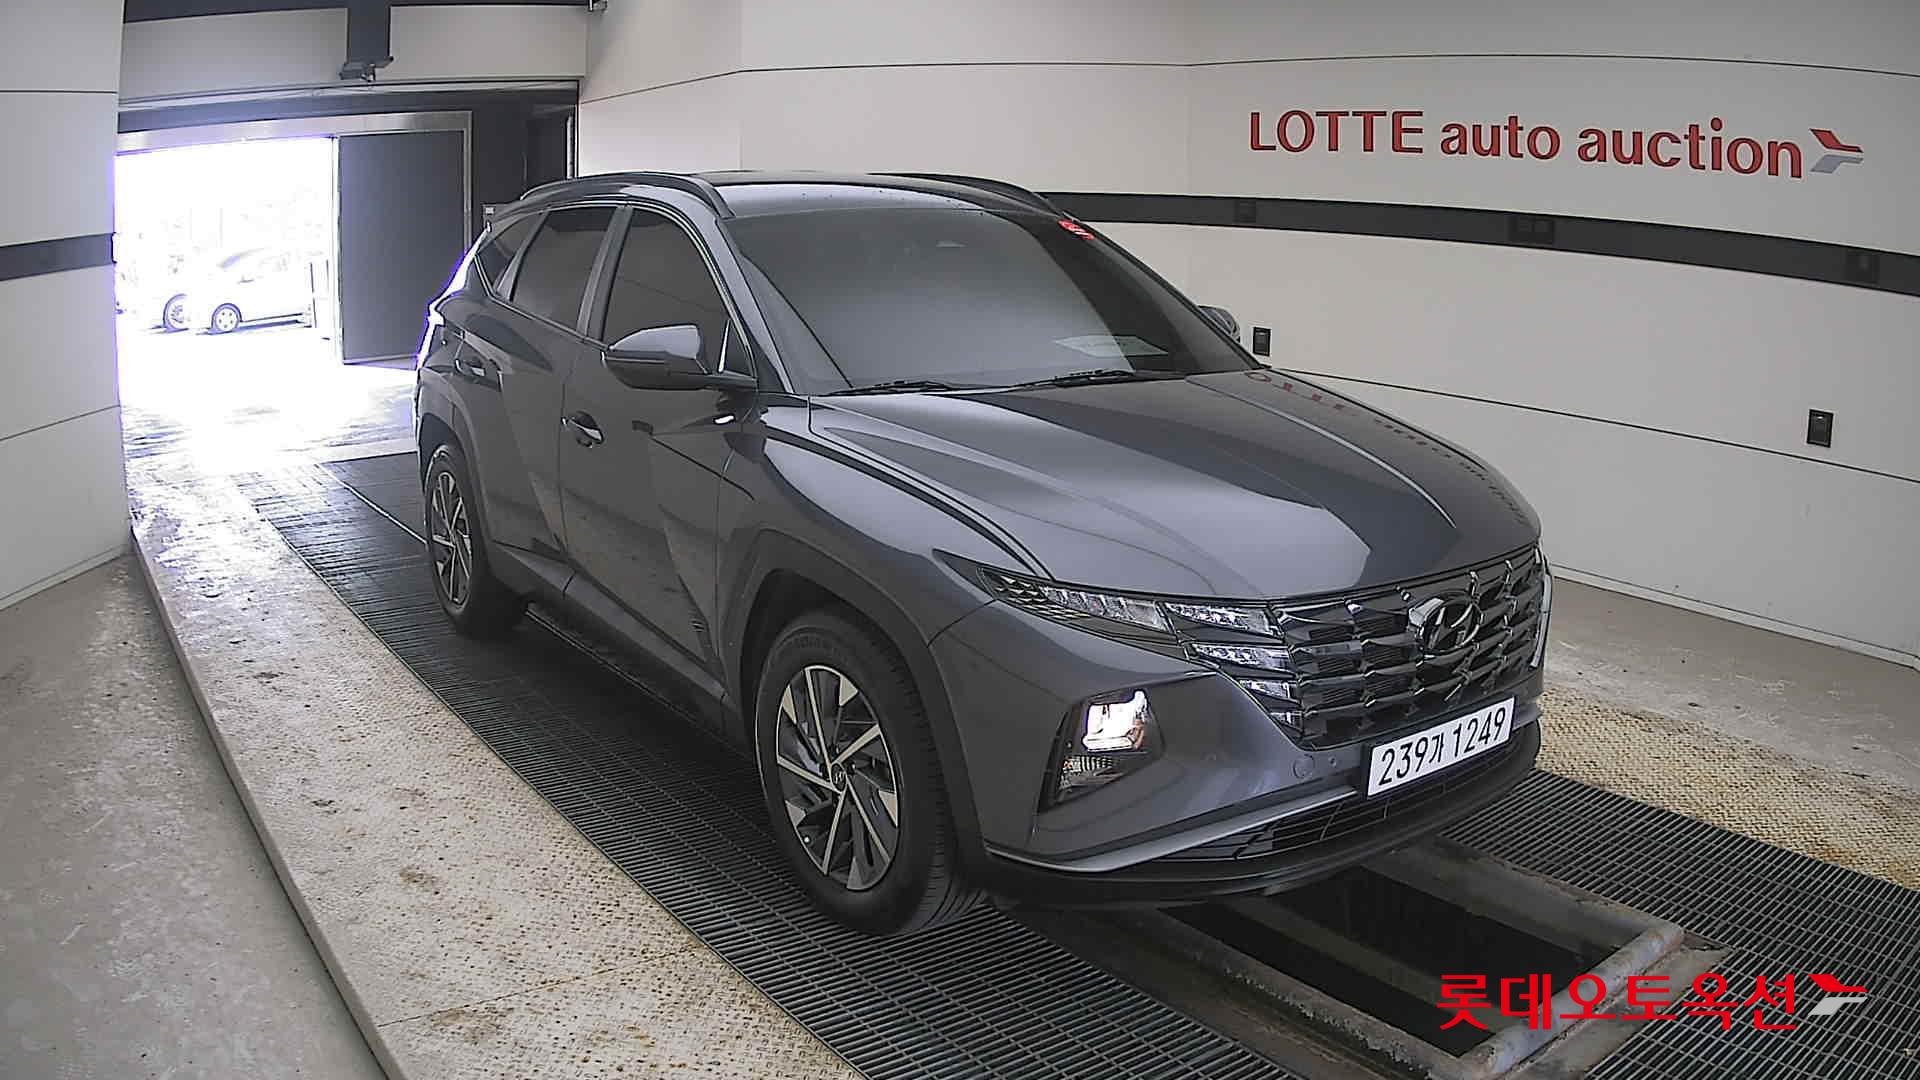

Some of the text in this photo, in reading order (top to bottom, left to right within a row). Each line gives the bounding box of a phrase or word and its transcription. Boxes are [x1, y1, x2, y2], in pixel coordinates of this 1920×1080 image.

[1250, 110, 1803, 178] LOTTE auto auction
[1378, 707, 1506, 786] 239가 1249
